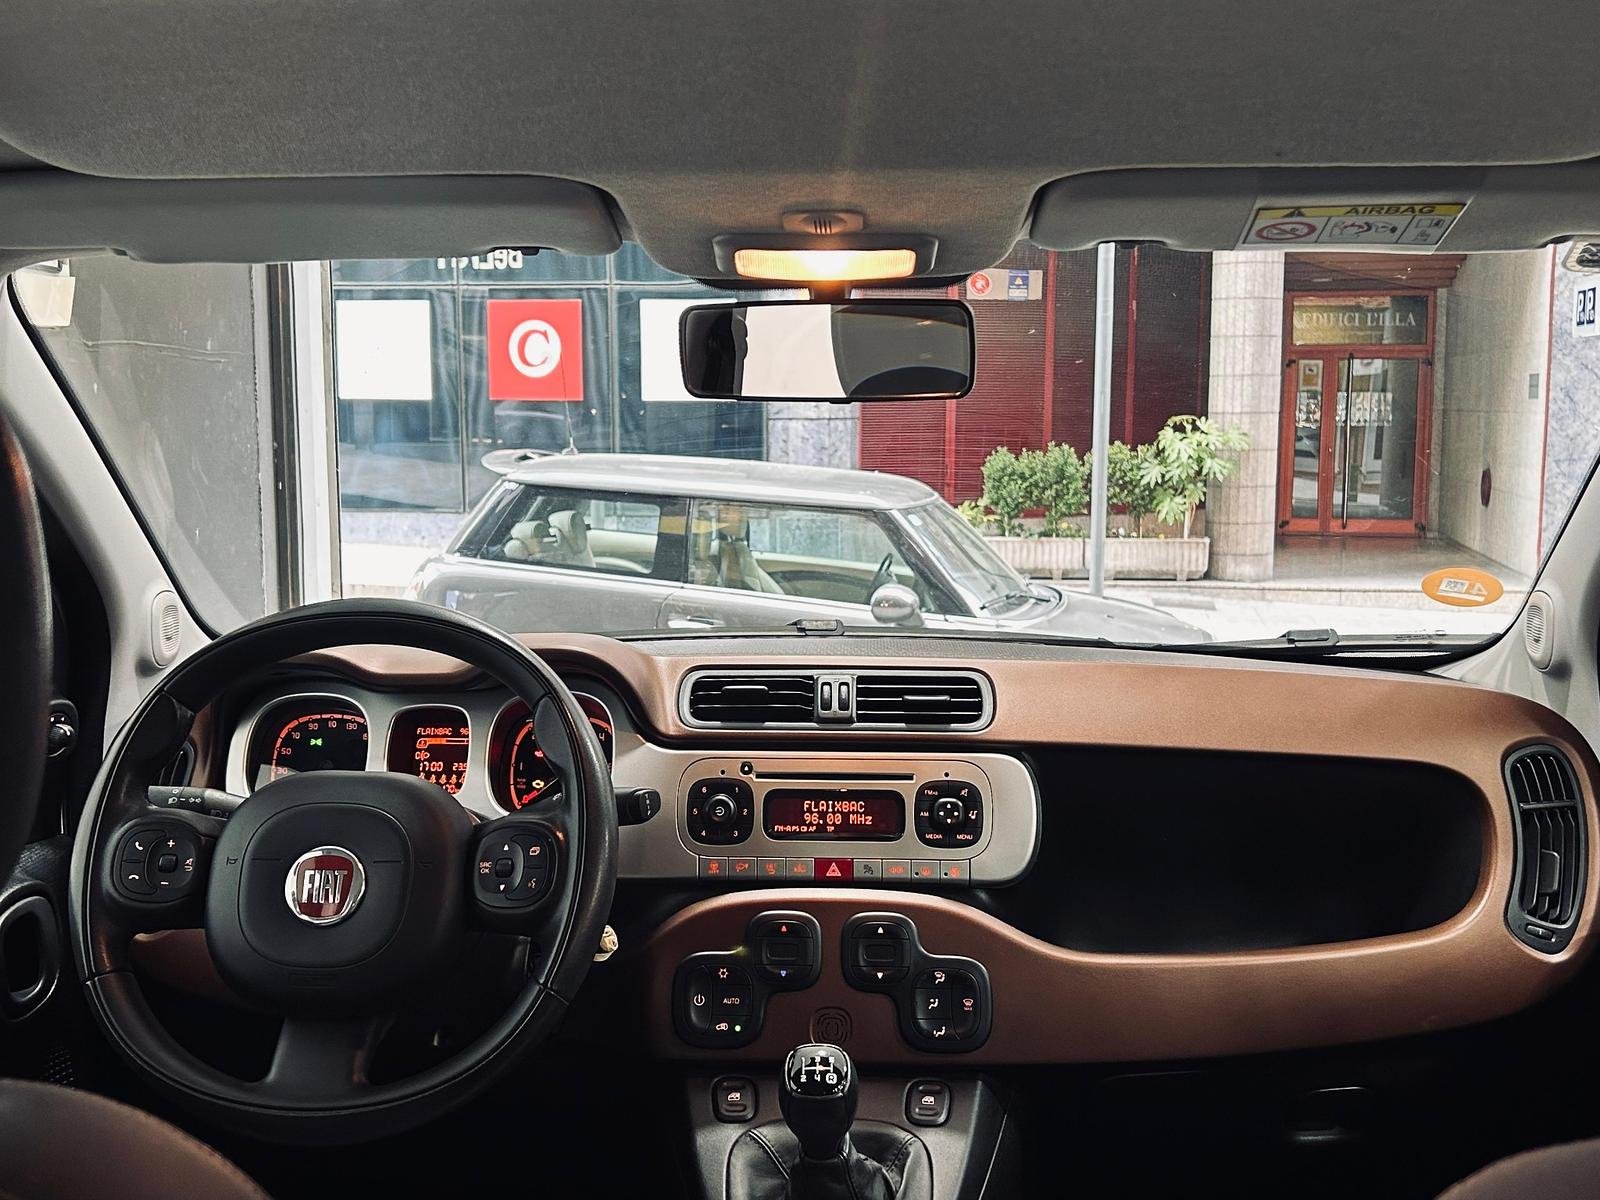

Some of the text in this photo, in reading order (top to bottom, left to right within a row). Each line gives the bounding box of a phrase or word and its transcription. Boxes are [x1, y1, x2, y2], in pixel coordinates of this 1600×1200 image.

[1343, 205, 1437, 216] AIRBAG
[1302, 311, 1417, 327] EDIFICI L'ILLA
[517, 329, 550, 368] C
[308, 722, 319, 730] 90
[291, 731, 301, 740] 70
[416, 727, 453, 736] FLAIXBAC
[281, 747, 292, 755] 50
[803, 800, 865, 812] FLAIXBAC
[803, 813, 873, 825] 96.00 MHz
[301, 869, 349, 904] FIAT
[723, 997, 740, 1005] AUTO
[800, 1074, 807, 1082] 2
[814, 1073, 821, 1082] 4
